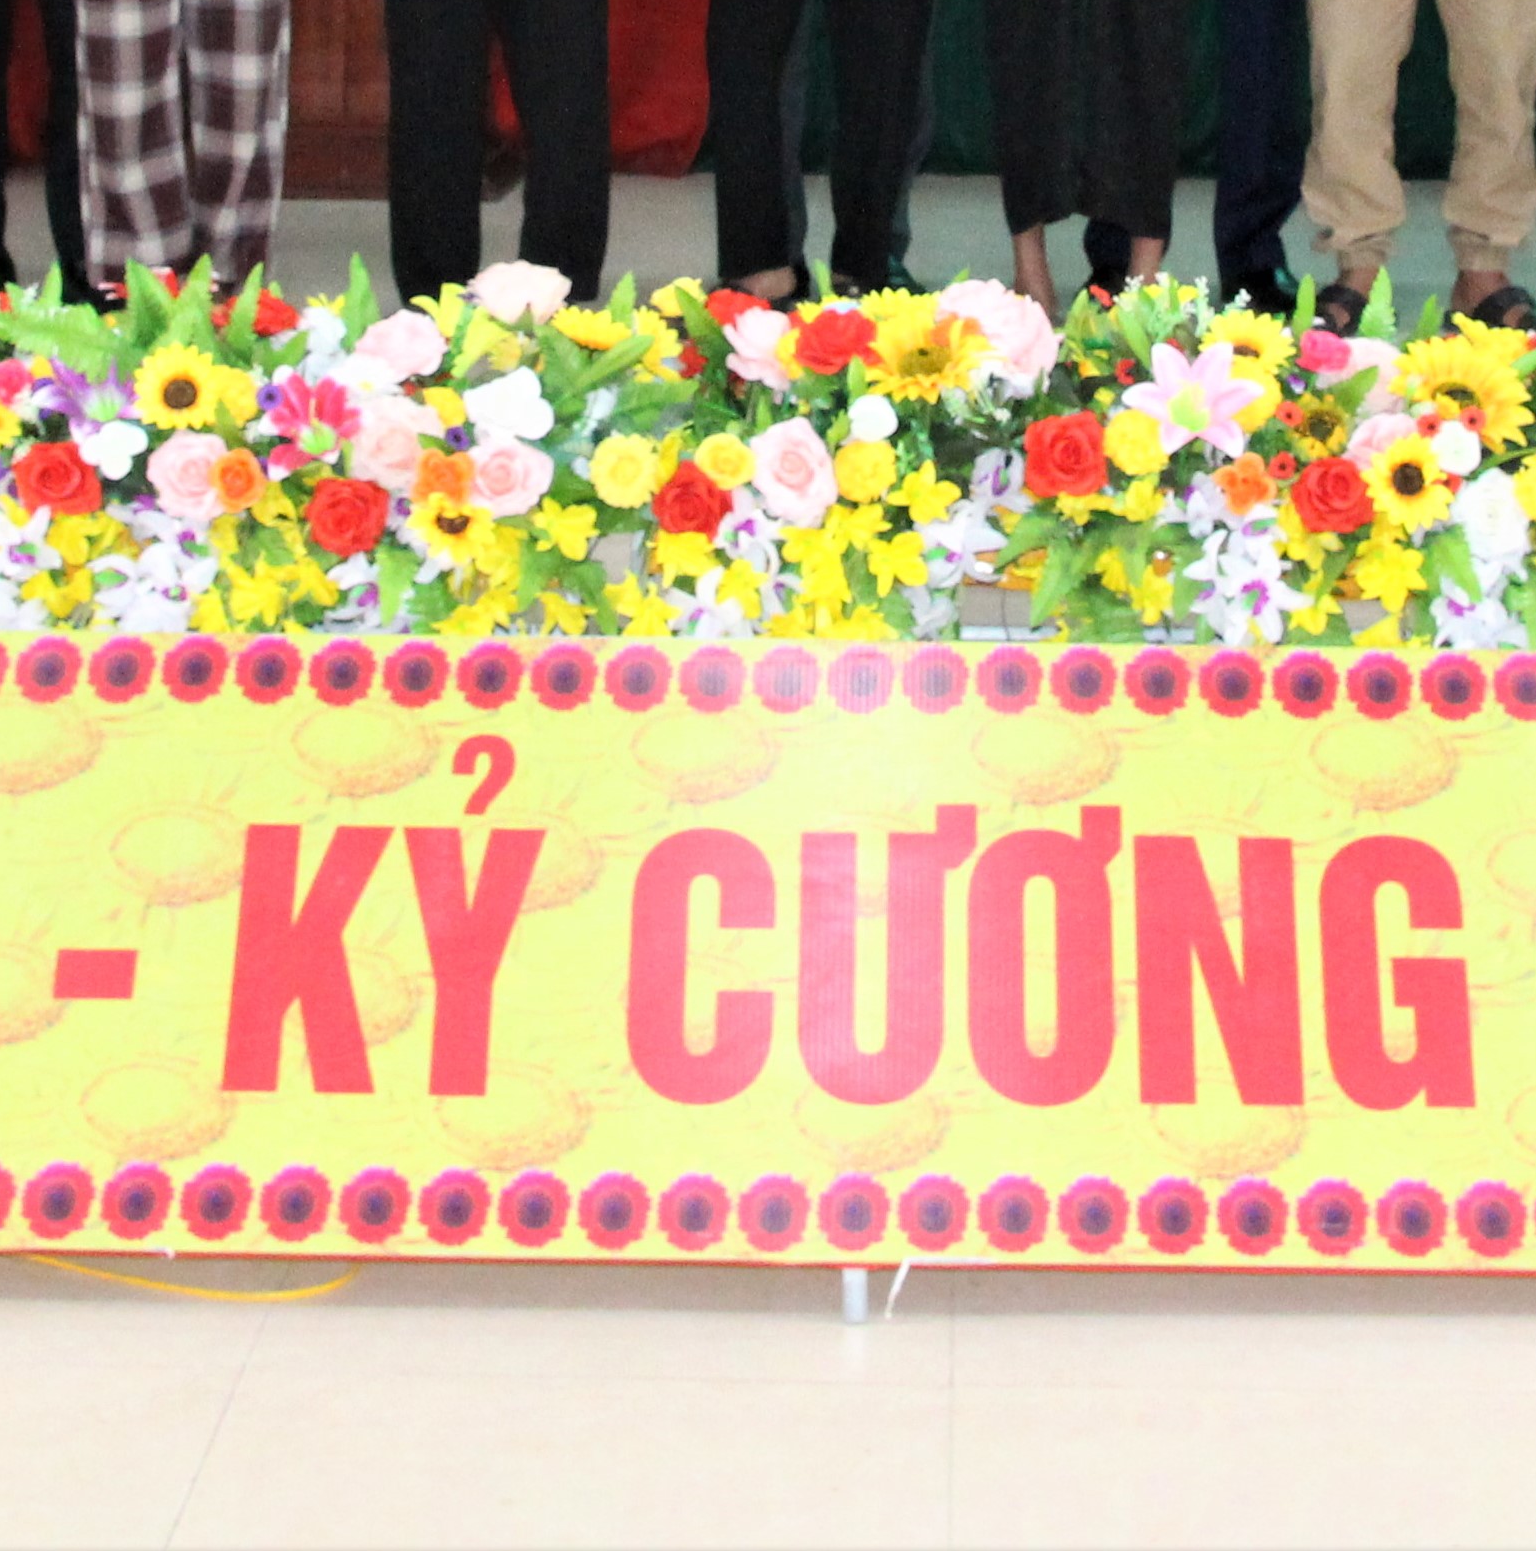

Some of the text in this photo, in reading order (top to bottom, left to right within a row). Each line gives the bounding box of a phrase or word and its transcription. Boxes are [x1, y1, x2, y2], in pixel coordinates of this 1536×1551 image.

[52, 948, 139, 1000] -
[220, 734, 548, 1097] KỶ
[625, 803, 1477, 1112] CƯƠNG
